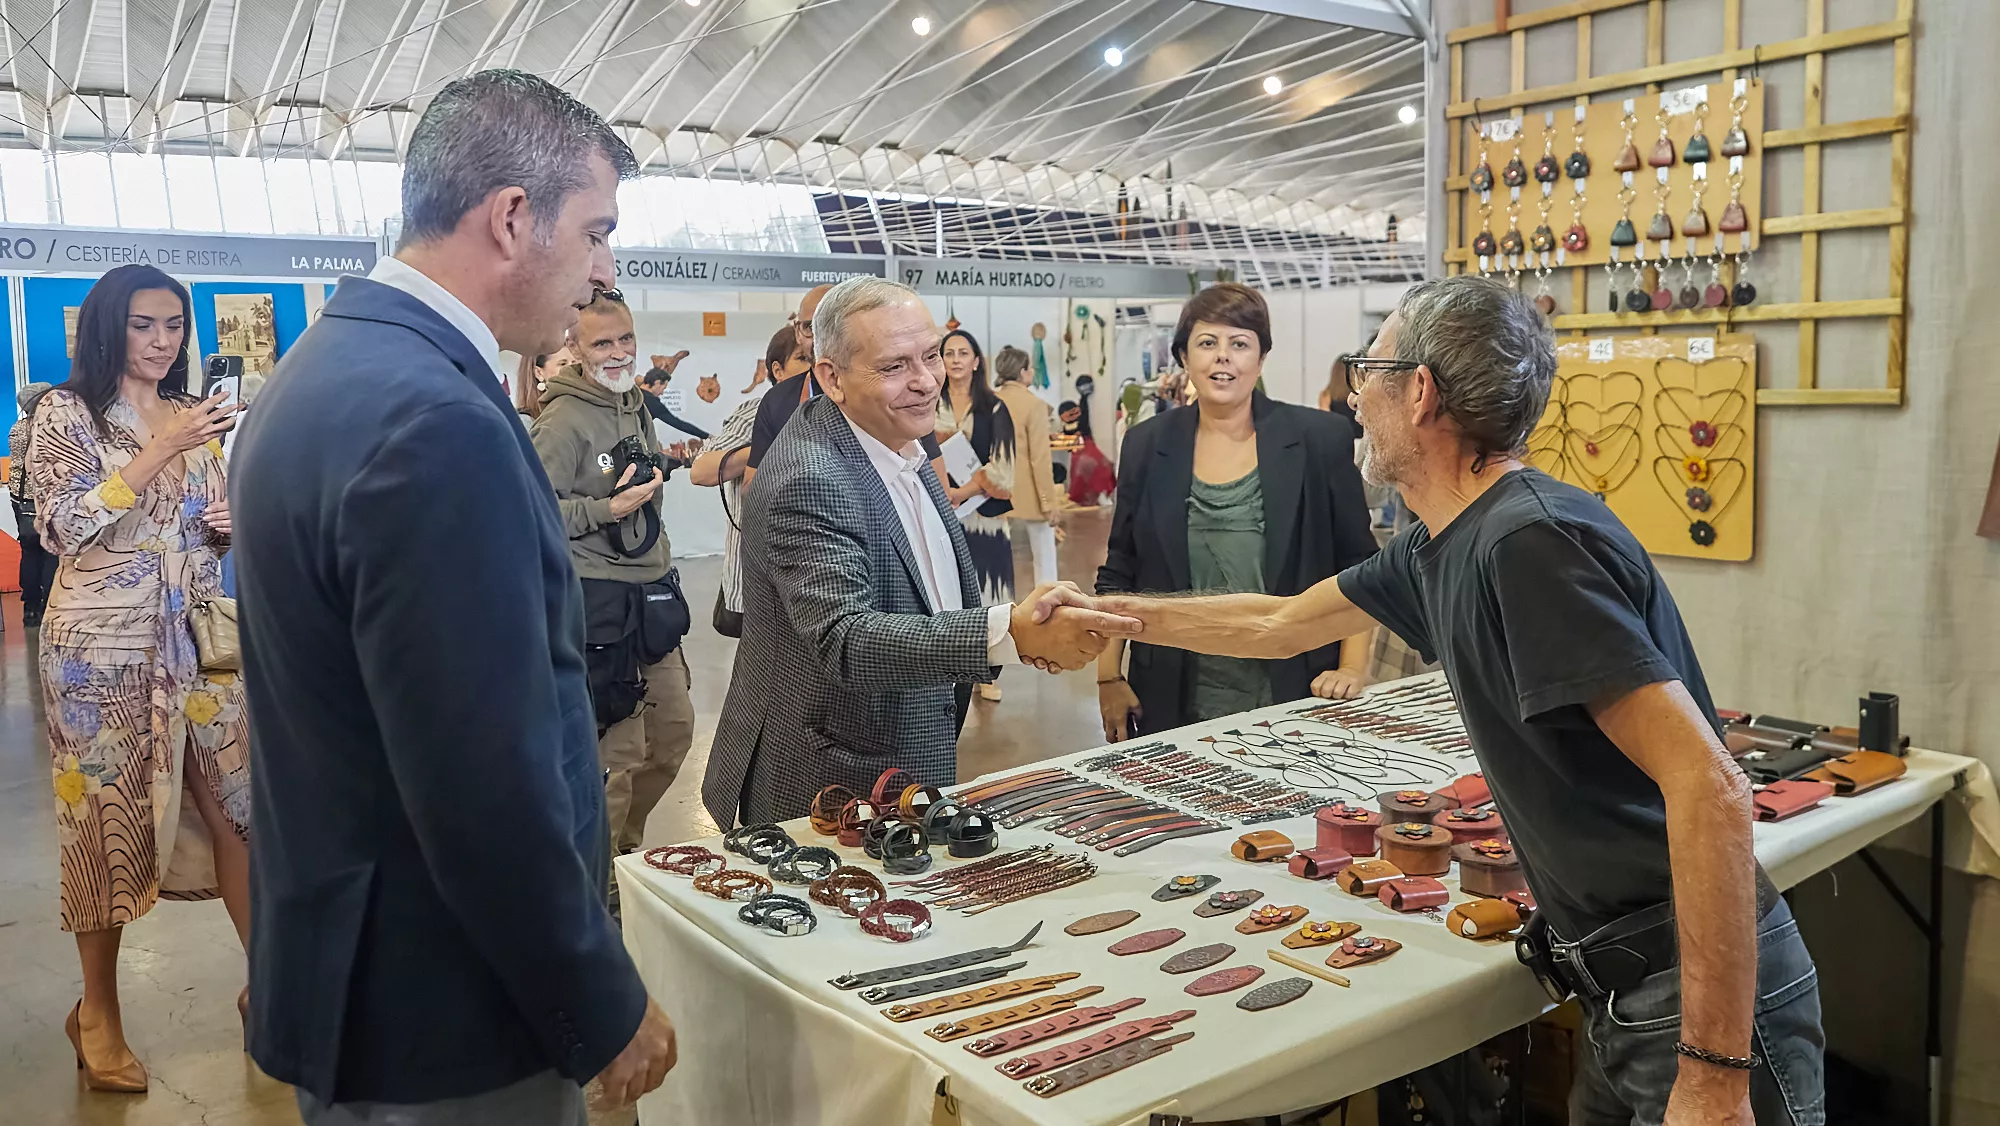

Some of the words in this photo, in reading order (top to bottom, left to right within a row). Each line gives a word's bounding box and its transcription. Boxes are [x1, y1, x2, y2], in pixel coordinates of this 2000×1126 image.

[1673, 93, 1690, 107] 5€
[1495, 121, 1511, 136] 7€
[0, 237, 37, 260] RO
[46, 239, 57, 263] /
[66, 244, 152, 263] CESTERÍA
[157, 249, 181, 265] DE
[186, 250, 242, 267] RISTRA
[291, 256, 310, 269] LA
[314, 257, 365, 271] PALMA
[627, 256, 708, 279] GONZÁLEZ
[711, 262, 718, 282] /
[722, 266, 781, 281] CERAMISTA
[905, 269, 923, 284] 97
[935, 266, 985, 287] MARÍA
[989, 271, 1056, 288] HURTADO
[1059, 272, 1066, 290] /
[1595, 343, 1610, 356] 4€
[1689, 340, 1710, 354] 6€
